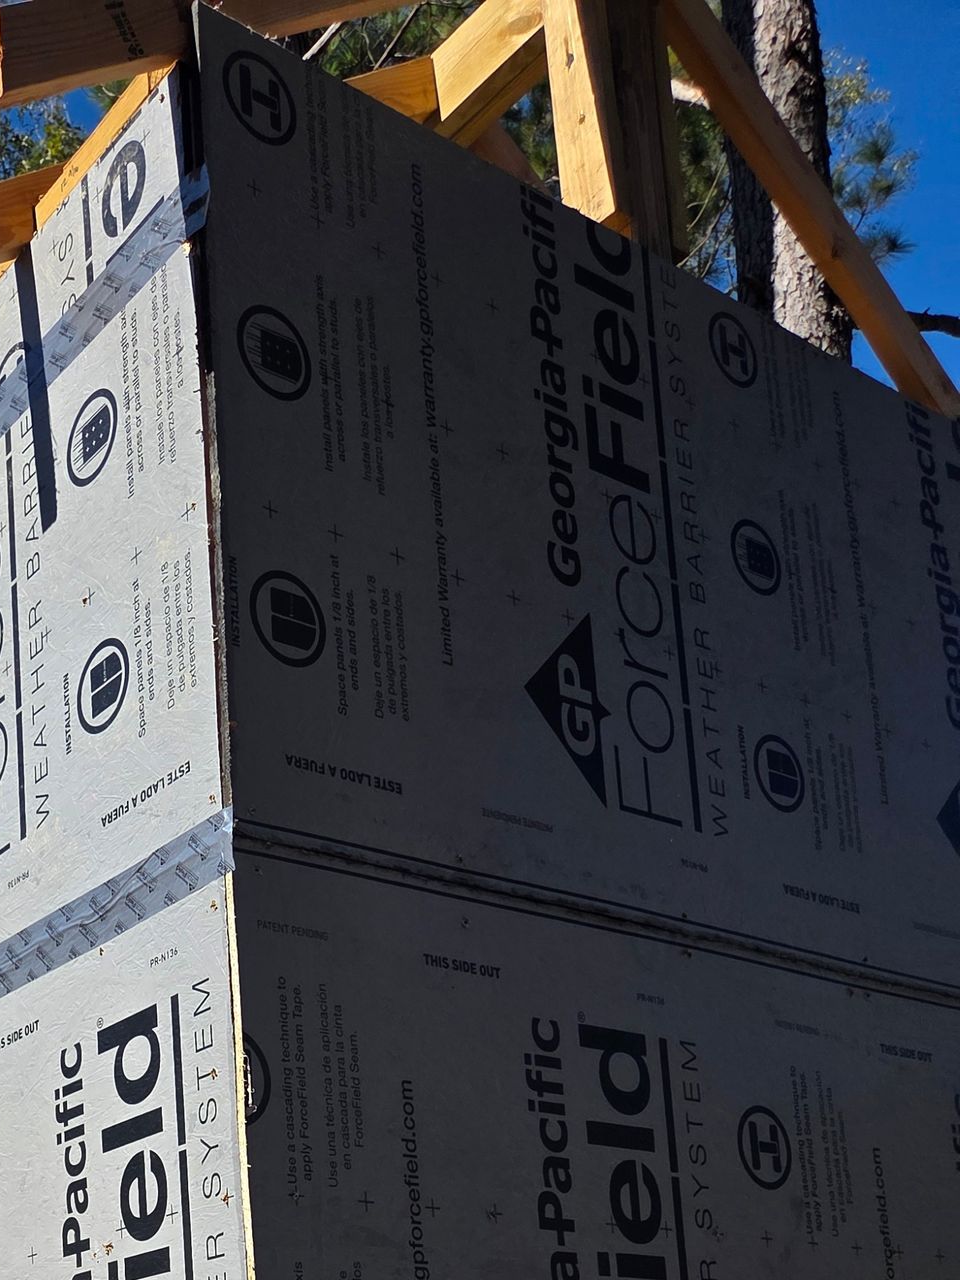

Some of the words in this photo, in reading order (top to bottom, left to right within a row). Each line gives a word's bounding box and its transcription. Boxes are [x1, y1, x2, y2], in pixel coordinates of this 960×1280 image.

[411, 164, 436, 427] warranty.gpforcefield.com
[427, 432, 439, 455] at:
[428, 457, 443, 528] available
[672, 420, 706, 603] BARRIER
[160, 561, 169, 584] 1/8
[172, 560, 180, 582] los
[183, 547, 193, 613] costados.
[434, 530, 449, 601] Warranty
[131, 577, 139, 592] at
[162, 585, 170, 603] de
[173, 582, 182, 616] entre
[132, 593, 140, 624] inch
[143, 597, 151, 638] sides.
[230, 556, 239, 647] INSTALLATION
[133, 624, 141, 647] 1/8
[164, 605, 173, 656] espacio
[187, 616, 196, 625] y
[438, 605, 454, 667] Limited
[145, 640, 153, 665] and
[175, 618, 186, 672] pulgada
[187, 625, 197, 688] extremos
[135, 648, 145, 693] panels
[167, 658, 173, 676] un
[177, 674, 185, 692] de
[146, 667, 155, 701] ends
[167, 678, 176, 710] Deje
[28, 600, 52, 830] WEATHER
[63, 673, 72, 755] INSTALLATION
[138, 695, 147, 738] Space
[558, 655, 599, 755] GP
[694, 629, 729, 837] WEATHER
[166, 760, 190, 786] ESTE
[285, 754, 325, 775] FUERA
[327, 763, 337, 777] A
[339, 767, 375, 787] LADO
[736, 725, 750, 800] INSTALLATION
[131, 794, 138, 808] A
[140, 777, 165, 802] LADO
[373, 775, 403, 795] ESTE
[100, 800, 129, 827] FUERA
[257, 919, 289, 932] PATENT
[291, 925, 329, 941] PENDING
[149, 947, 178, 968] PR-N136
[422, 952, 450, 970] THIS
[451, 958, 477, 975] SIDE
[479, 964, 501, 979] OUT
[276, 975, 286, 990] to
[292, 984, 304, 1019] Tape.
[317, 983, 331, 1052] aplicación
[6, 1027, 23, 1045] SIDE
[24, 1019, 39, 1036] OUT
[278, 993, 290, 1062] technique
[333, 1004, 343, 1037] cinta
[294, 1023, 305, 1063] Seam
[334, 1041, 344, 1052] la
[349, 1031, 360, 1073] Seam.
[321, 1055, 331, 1073] de
[337, 1057, 348, 1087] para
[191, 978, 222, 1199] SYSTEM
[281, 1067, 295, 1140] cascading
[295, 1066, 309, 1139] ForceField
[323, 1077, 335, 1127] técnica
[337, 1091, 350, 1149] cascada
[350, 1076, 364, 1148] ForceField
[287, 1143, 295, 1152] a
[327, 1131, 337, 1156] una
[679, 1040, 713, 1230] SYSTEM
[286, 1156, 297, 1188] Use
[299, 1142, 314, 1181] apply
[327, 1160, 339, 1188] Use
[343, 1153, 352, 1170] en
